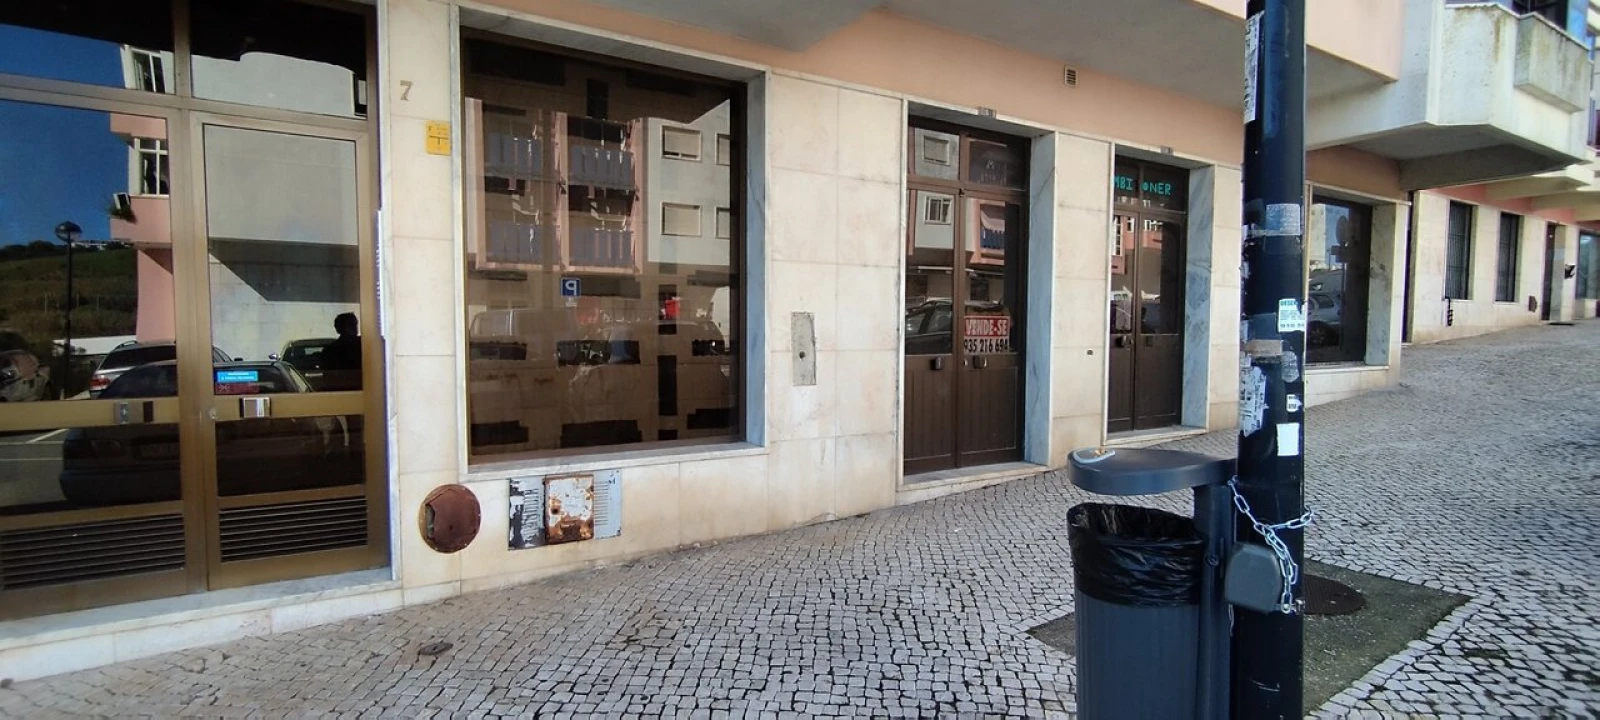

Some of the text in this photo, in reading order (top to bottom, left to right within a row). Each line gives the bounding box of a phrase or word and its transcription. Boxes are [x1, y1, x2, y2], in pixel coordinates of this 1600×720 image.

[400, 80, 413, 101] 7
[965, 319, 1007, 335] VENDE-SE
[979, 338, 993, 352] 216
